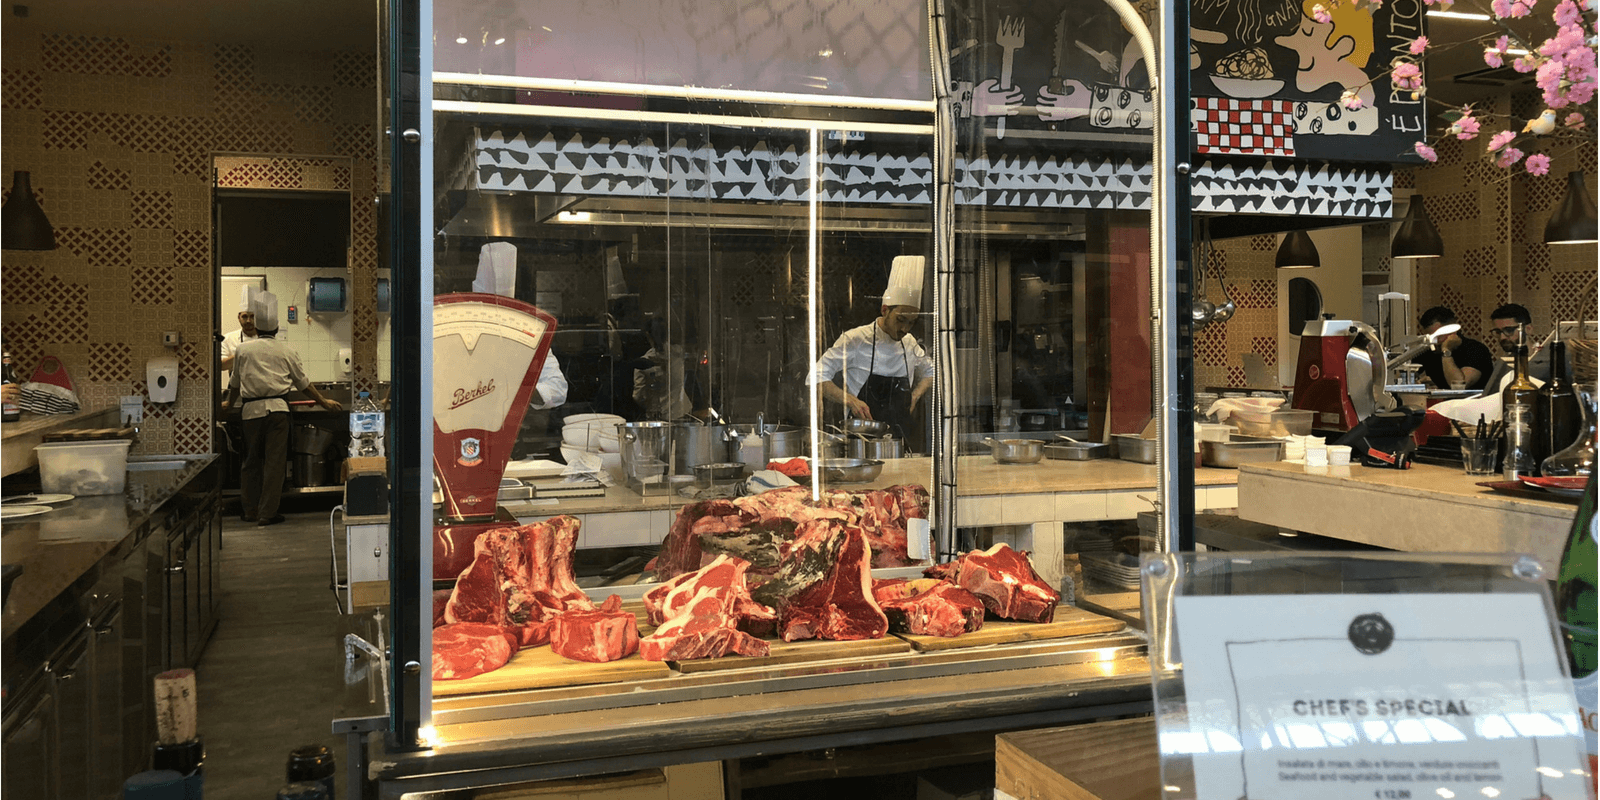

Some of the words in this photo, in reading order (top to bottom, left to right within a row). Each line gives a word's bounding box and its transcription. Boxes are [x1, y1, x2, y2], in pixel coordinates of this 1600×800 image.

[1265, 0, 1299, 26] GNA
[450, 378, 496, 408] Berkel
[1375, 699, 1472, 716] SPECIAL
